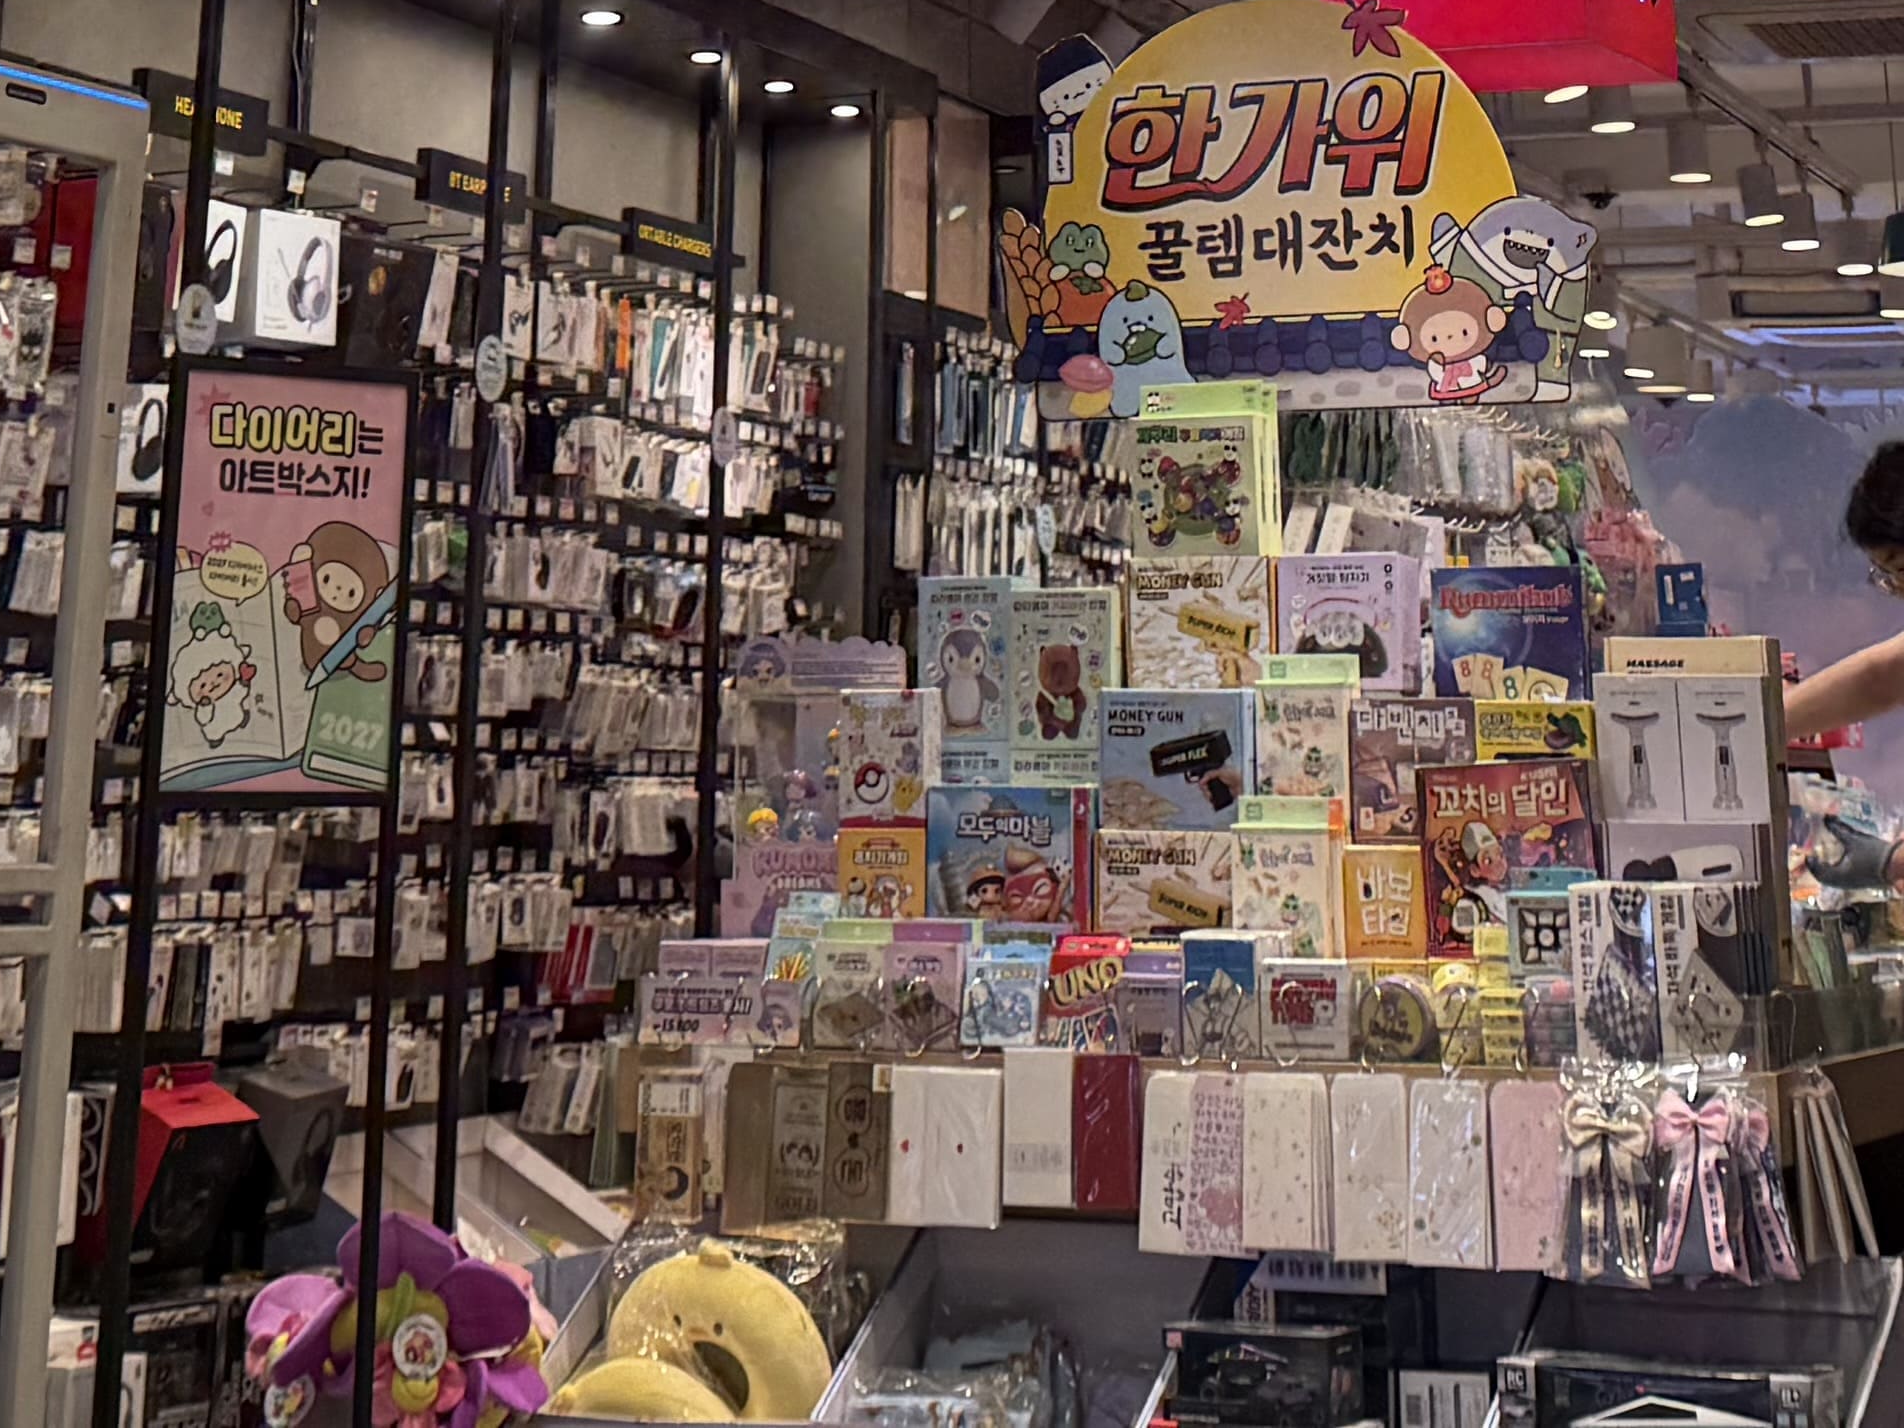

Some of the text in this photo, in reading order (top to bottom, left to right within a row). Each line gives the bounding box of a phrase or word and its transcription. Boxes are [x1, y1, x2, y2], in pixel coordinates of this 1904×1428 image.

[1102, 71, 1445, 211] 한가위
[210, 401, 384, 458] 다이어리는
[220, 458, 371, 499] 아트박스지!
[1137, 573, 1189, 590] MONEY
[319, 712, 385, 750] 2027
[1108, 709, 1184, 723] MONEY GUN
[1511, 778, 1570, 817] 달인
[1105, 847, 1162, 866] MONEY
[1051, 957, 1124, 1008] UNO
